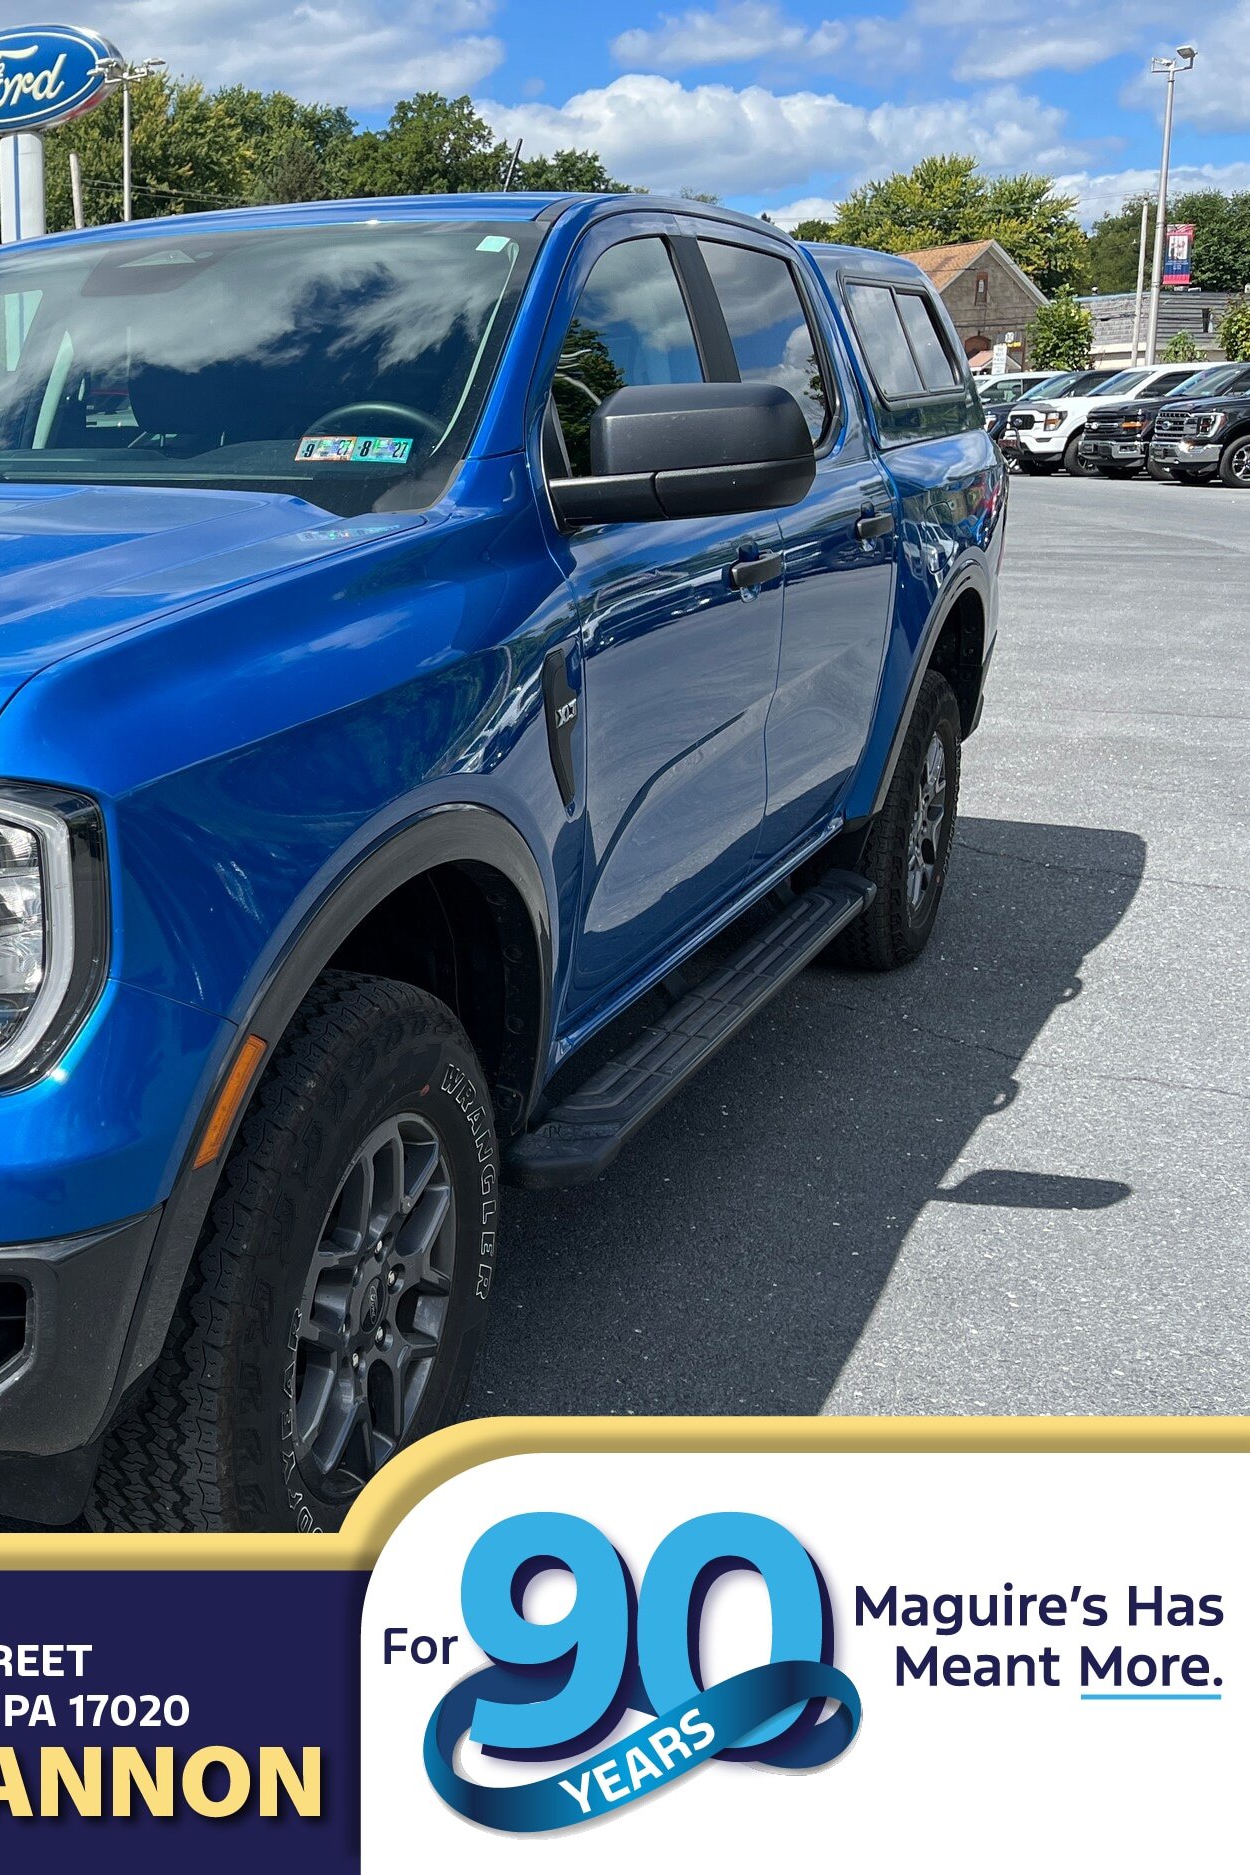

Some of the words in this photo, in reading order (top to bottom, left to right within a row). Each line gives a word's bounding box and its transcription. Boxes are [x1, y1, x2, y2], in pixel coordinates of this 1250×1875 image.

[304, 443, 315, 458] 9
[337, 439, 353, 456] 27
[360, 440, 372, 457] 8
[392, 442, 408, 459] 27
[555, 698, 577, 729] XLT
[440, 1063, 497, 1300] WRANGLER
